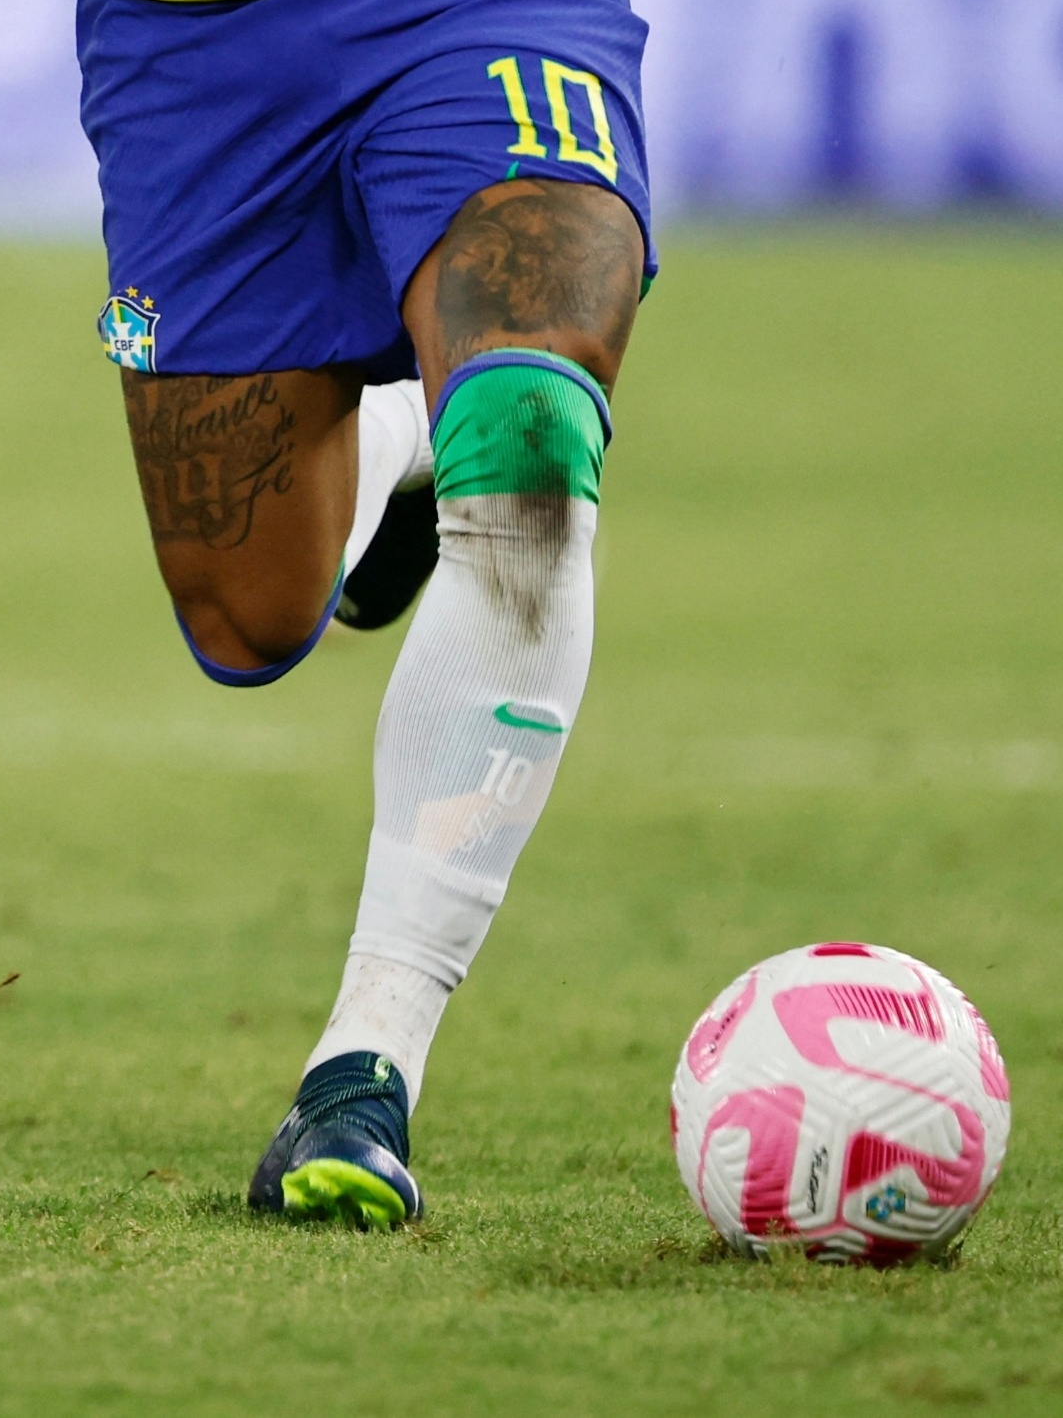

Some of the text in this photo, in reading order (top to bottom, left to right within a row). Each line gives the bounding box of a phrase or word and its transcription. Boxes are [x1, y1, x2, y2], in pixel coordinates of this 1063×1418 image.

[486, 55, 618, 186] 10
[114, 339, 135, 352] CBF
[480, 747, 534, 807] 10
